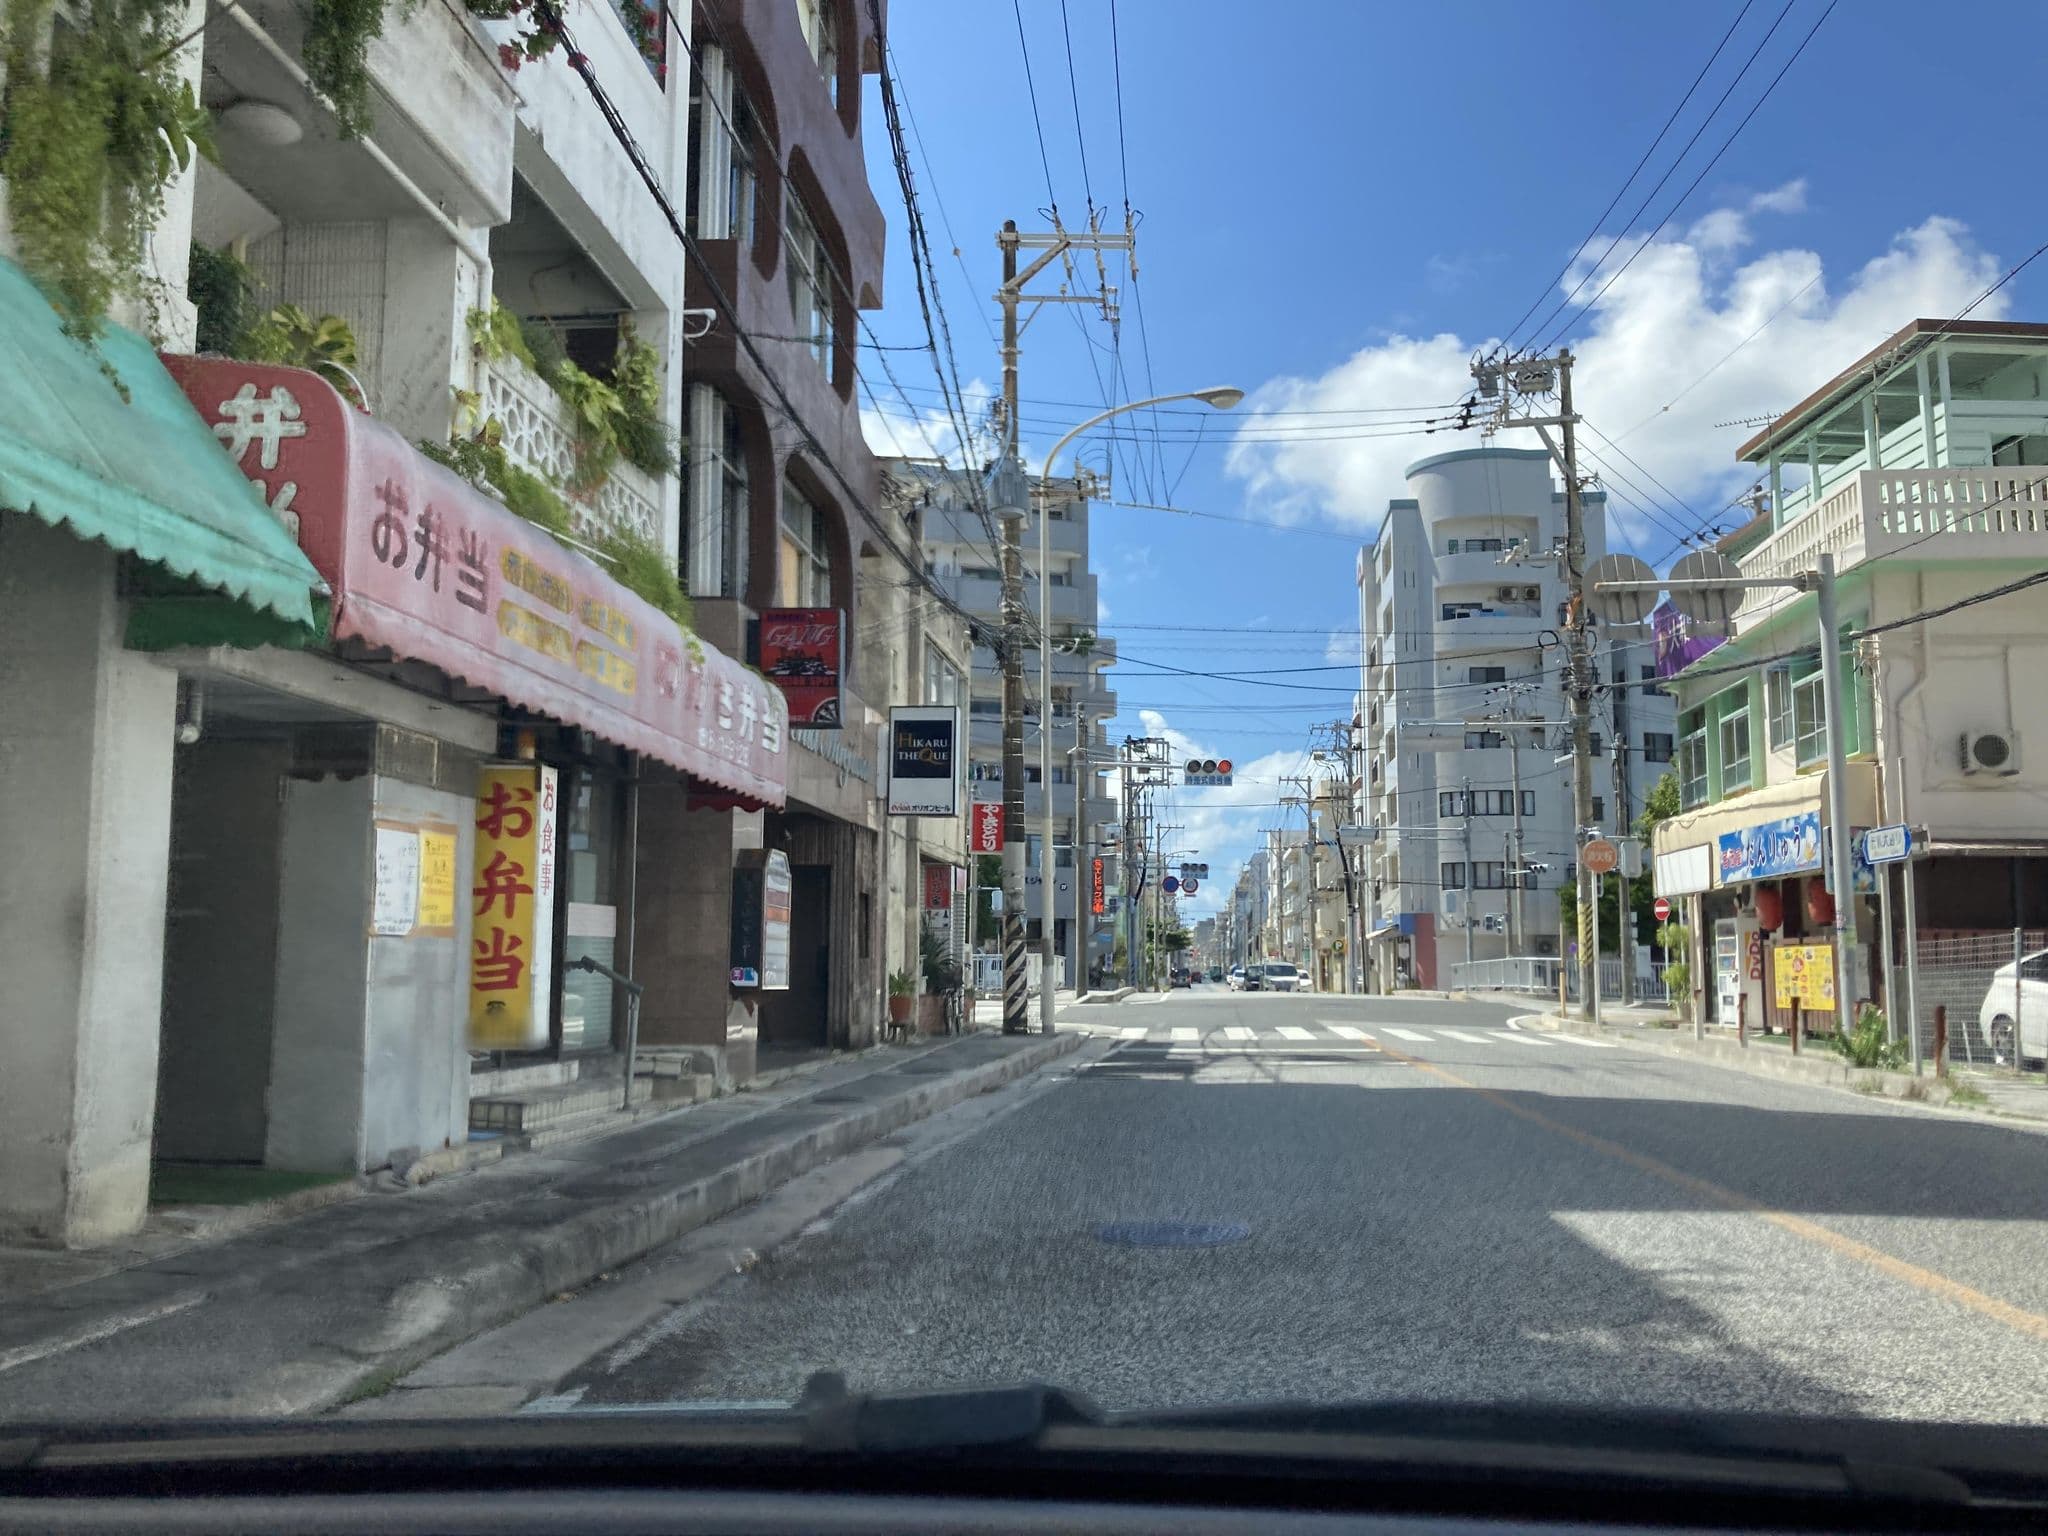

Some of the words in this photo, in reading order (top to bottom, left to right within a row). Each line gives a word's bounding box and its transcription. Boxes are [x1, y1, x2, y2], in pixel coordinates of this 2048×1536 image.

[372, 477, 490, 615] お弁当
[898, 732, 948, 747] HIKARU
[472, 781, 534, 993] お弁当
[540, 776, 555, 897] お食事
